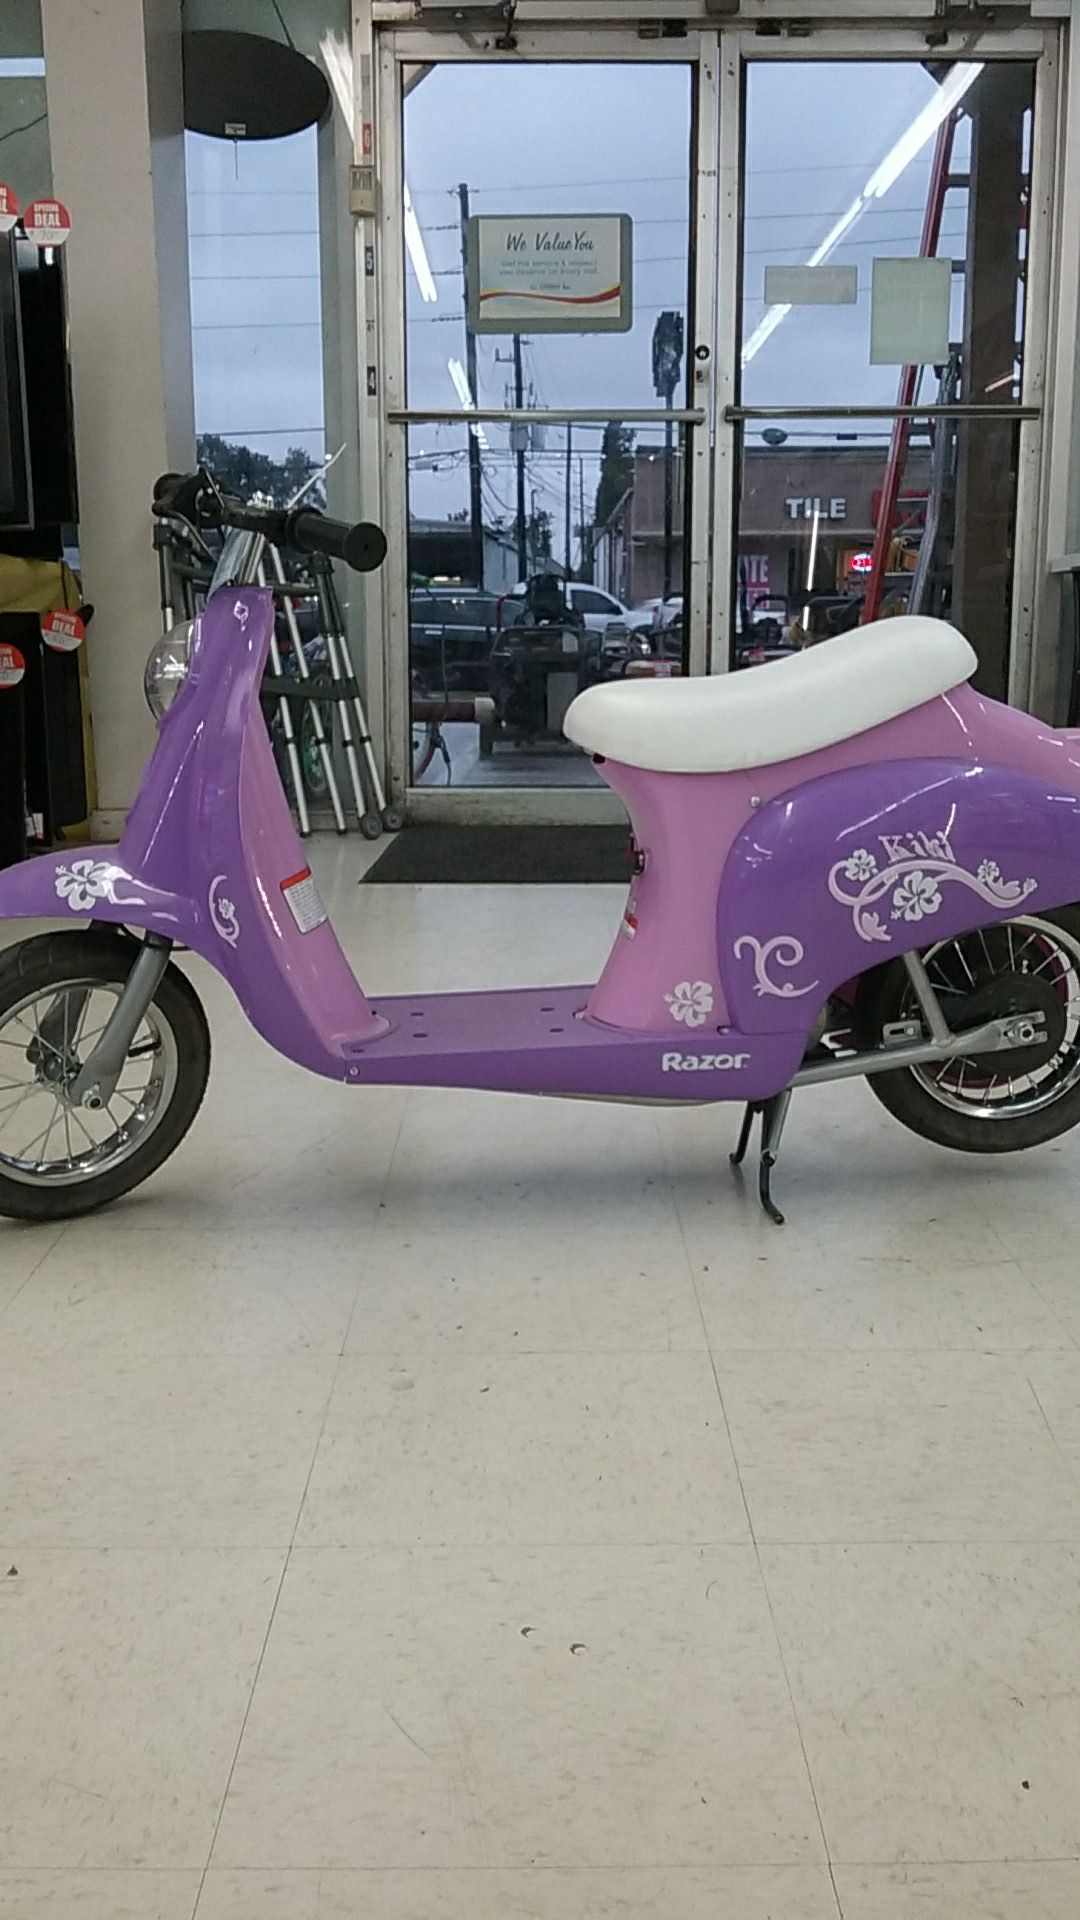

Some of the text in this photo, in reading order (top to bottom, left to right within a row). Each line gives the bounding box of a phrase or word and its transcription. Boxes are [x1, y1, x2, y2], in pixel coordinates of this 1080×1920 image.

[34, 213, 61, 227] DEAL
[507, 230, 595, 251] We Value You
[785, 498, 846, 519] TILE
[52, 619, 76, 636] DEAL
[662, 1052, 751, 1072] Razor
